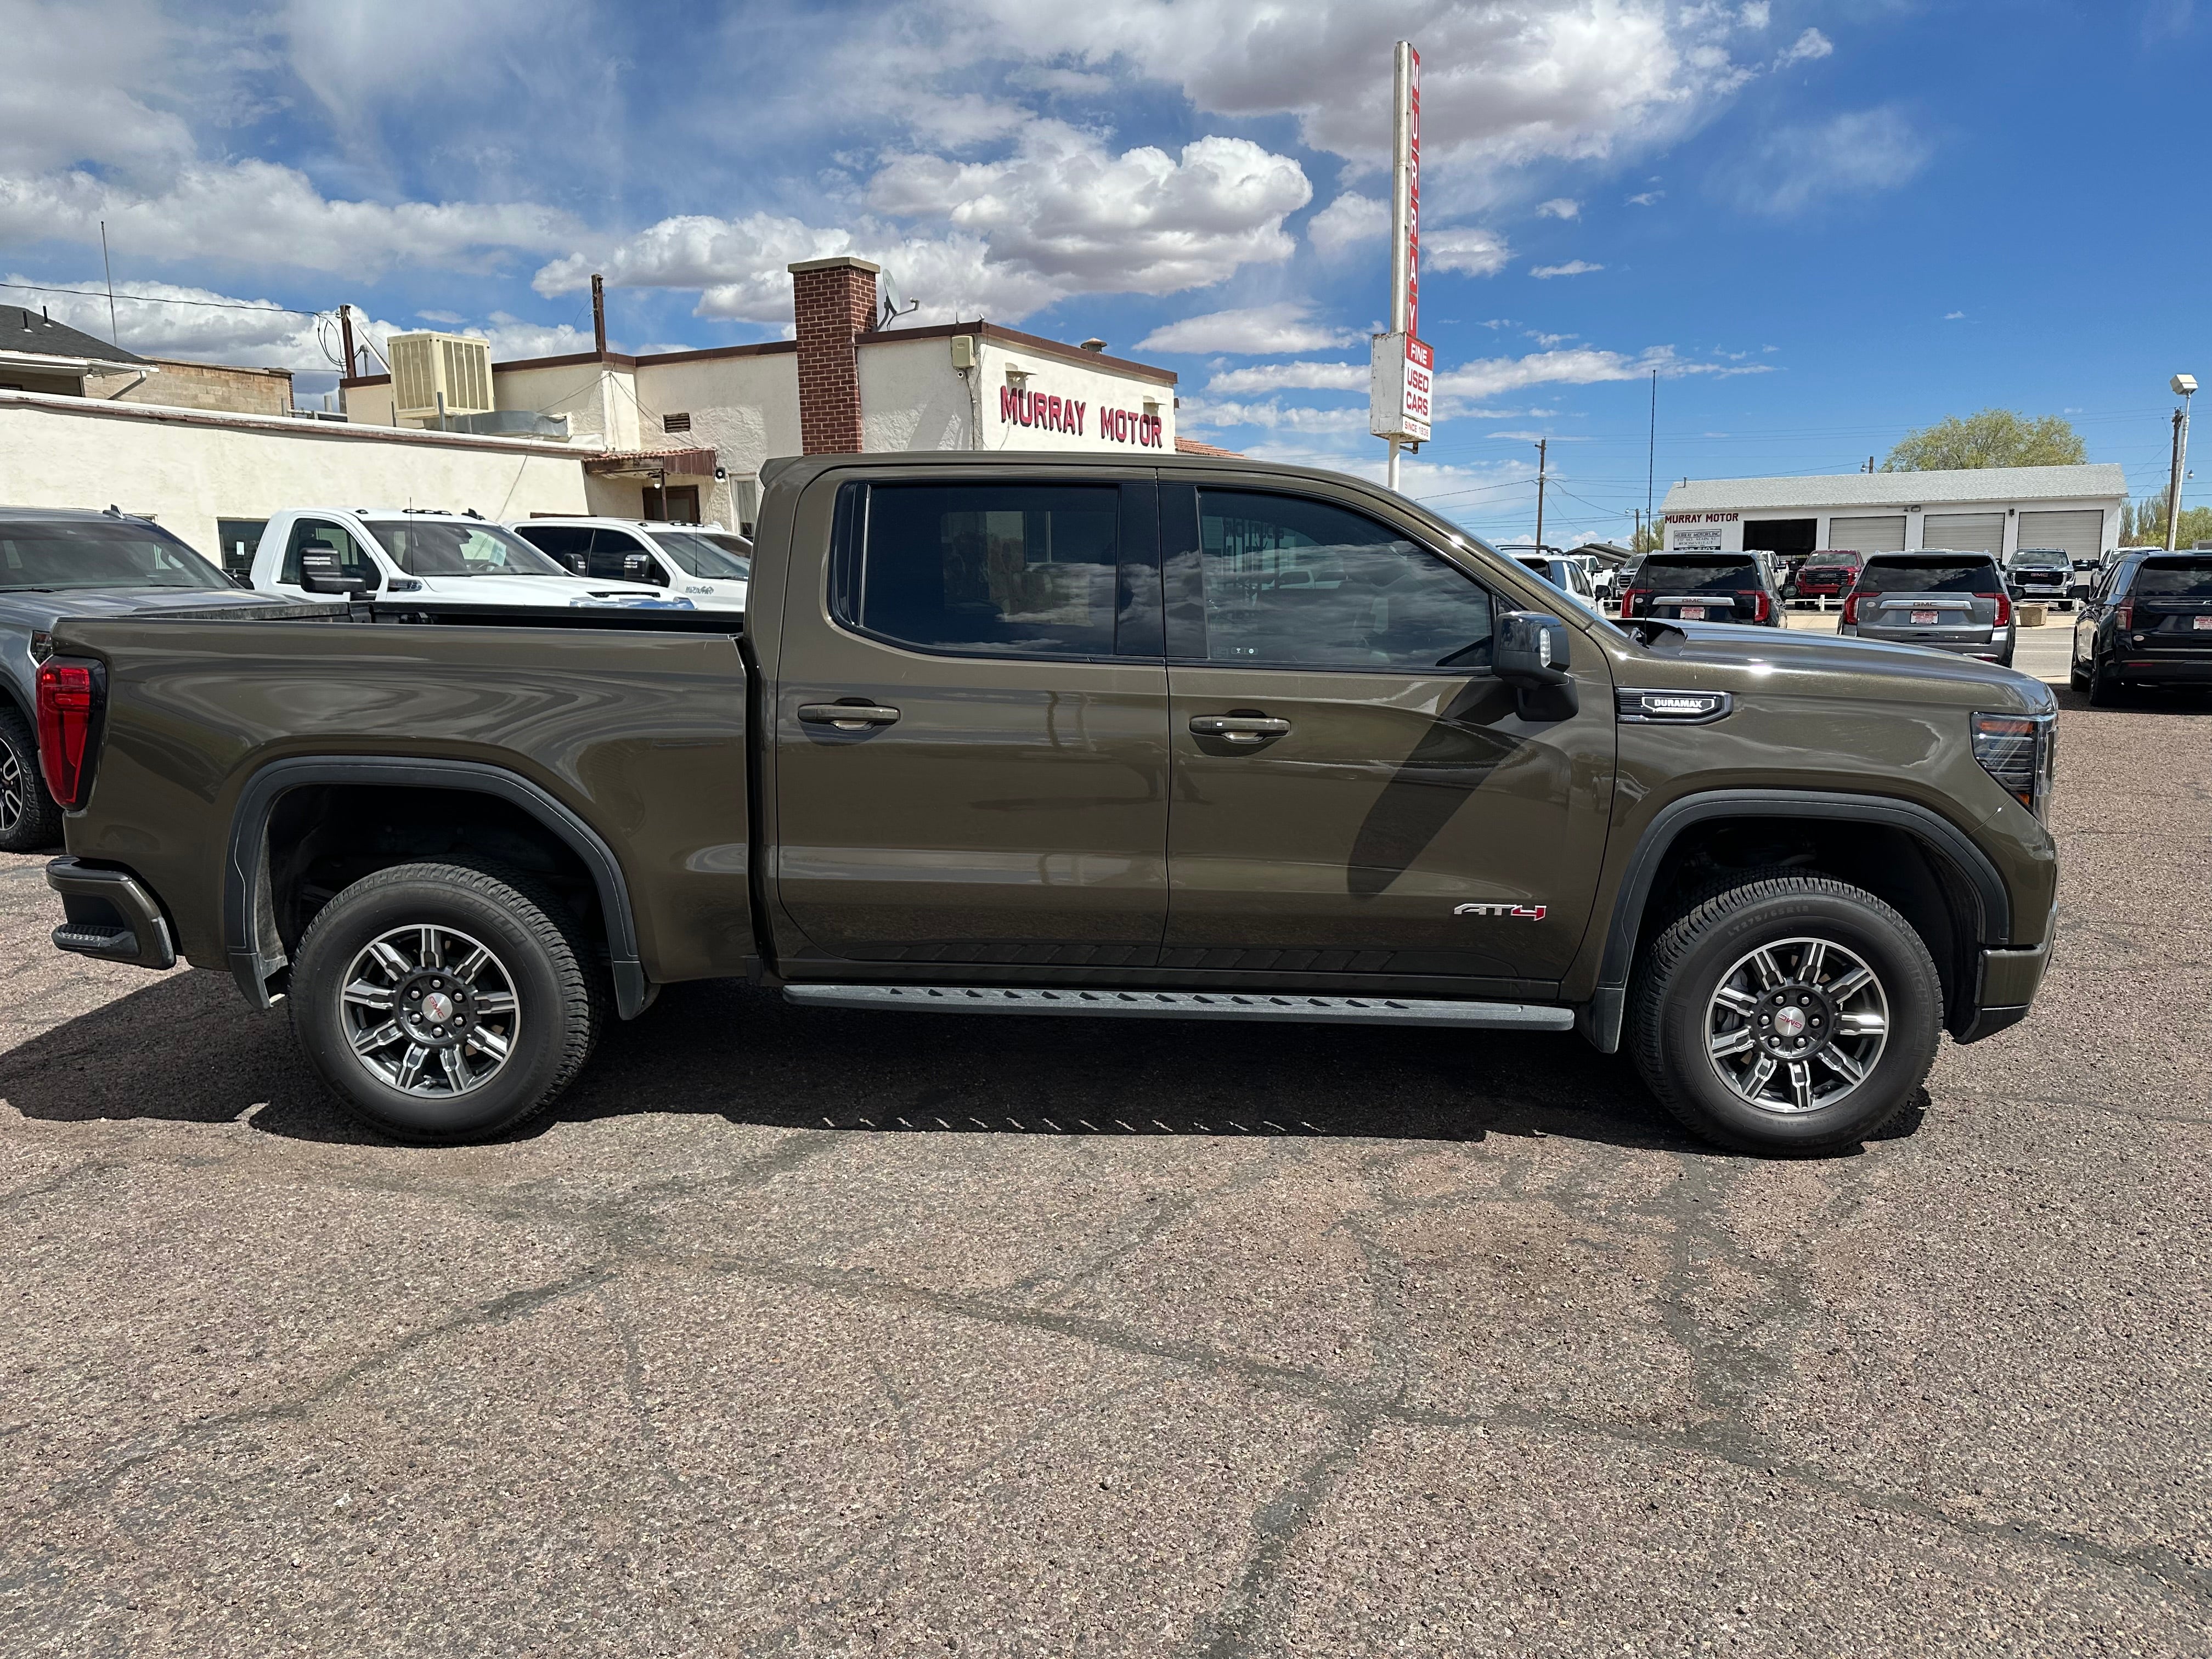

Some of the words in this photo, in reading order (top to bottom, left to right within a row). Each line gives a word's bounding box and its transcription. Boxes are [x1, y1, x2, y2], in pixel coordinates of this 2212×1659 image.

[1409, 58, 1419, 330] MURRAY
[1411, 342, 1427, 365] FINE
[1407, 366, 1429, 393] USED
[1406, 391, 1428, 416] CARS
[1000, 385, 1086, 436] MURRAY
[1101, 406, 1163, 449] MOTOR
[1405, 421, 1417, 433] SINCE
[1665, 514, 1702, 524] MURRAY
[1706, 513, 1739, 522] MOTOR
[1654, 699, 1702, 708] DURAMAX
[1454, 903, 1547, 922] AT4
[429, 996, 445, 1019] GMC
[1778, 1013, 1802, 1029] GMC
